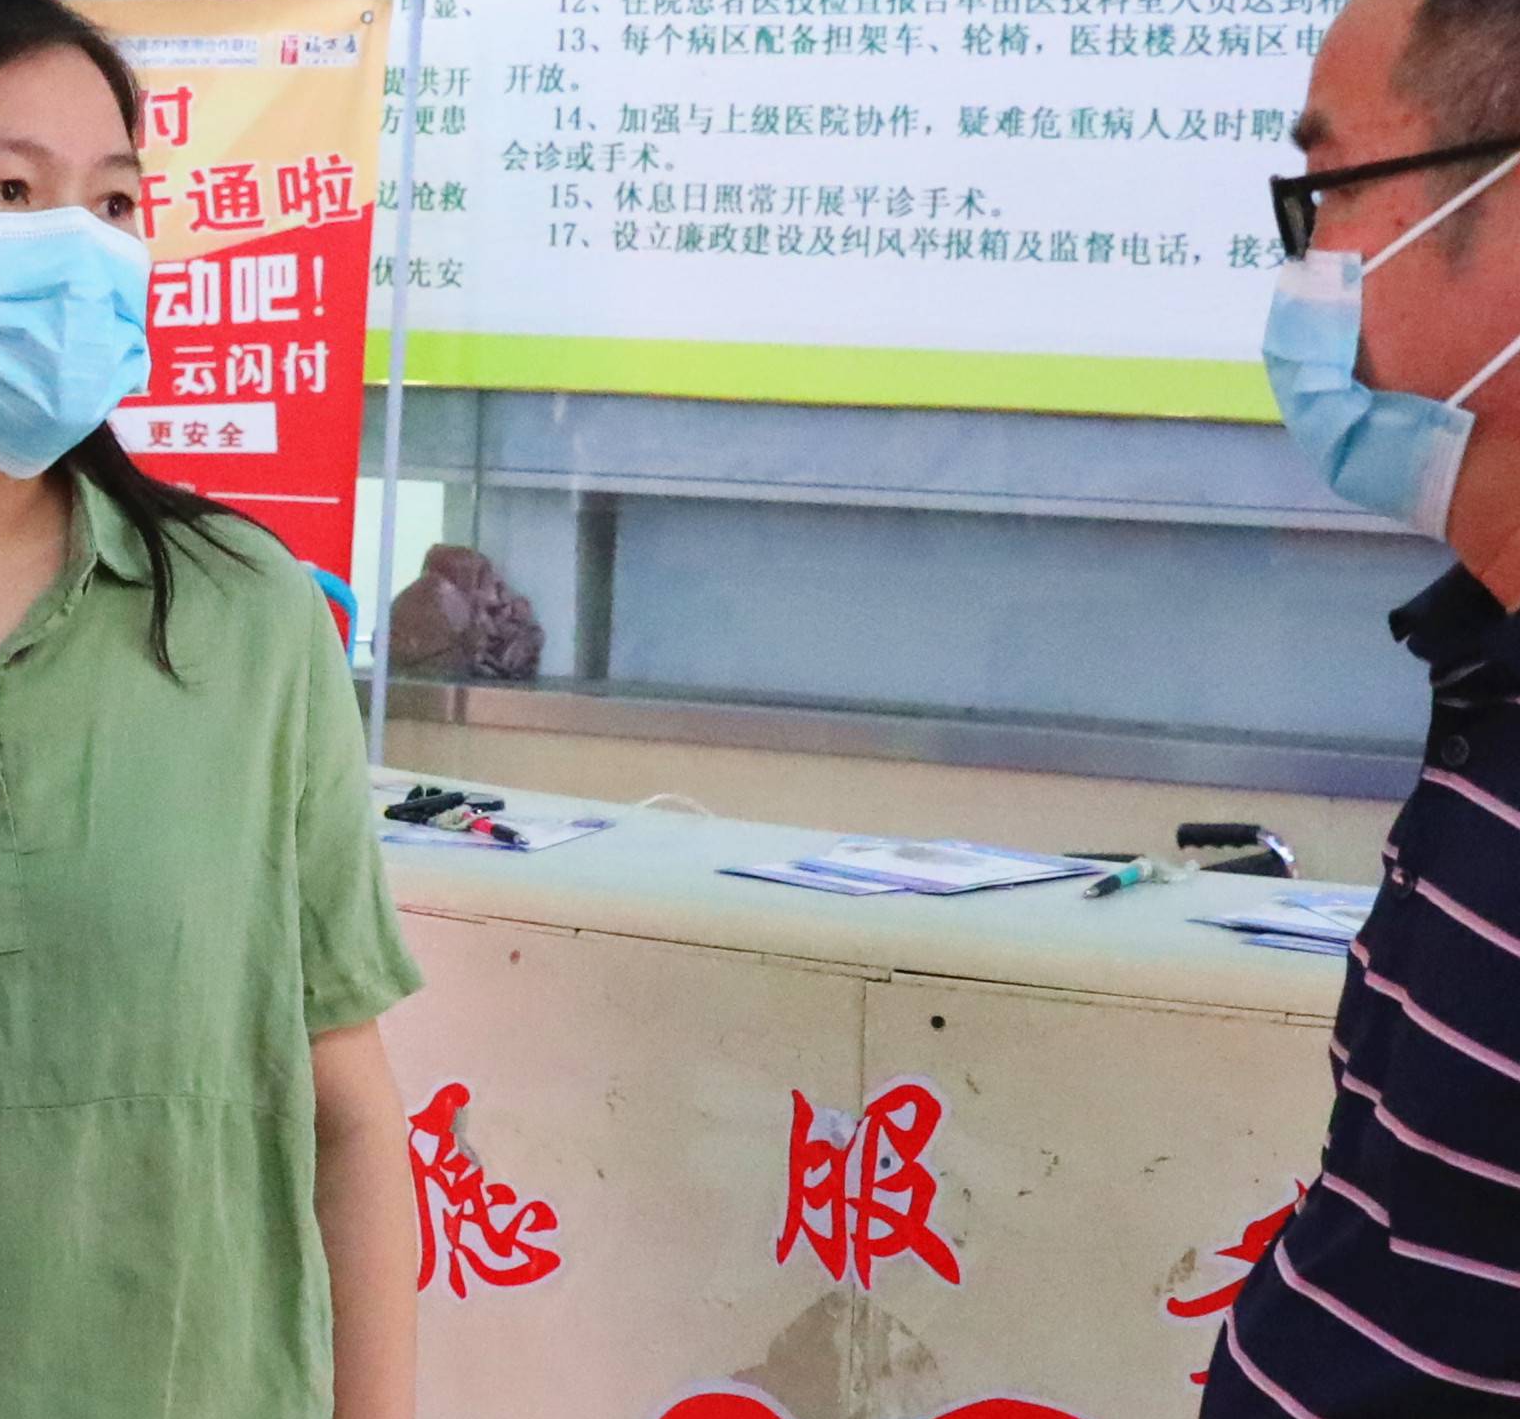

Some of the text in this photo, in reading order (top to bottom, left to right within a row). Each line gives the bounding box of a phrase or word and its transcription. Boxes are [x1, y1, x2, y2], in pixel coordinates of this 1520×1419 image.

[504, 62, 582, 94] 开放。
[501, 140, 677, 174] 会诊或手术。
[170, 341, 330, 396] 云闪付
[147, 420, 245, 447] 更安全
